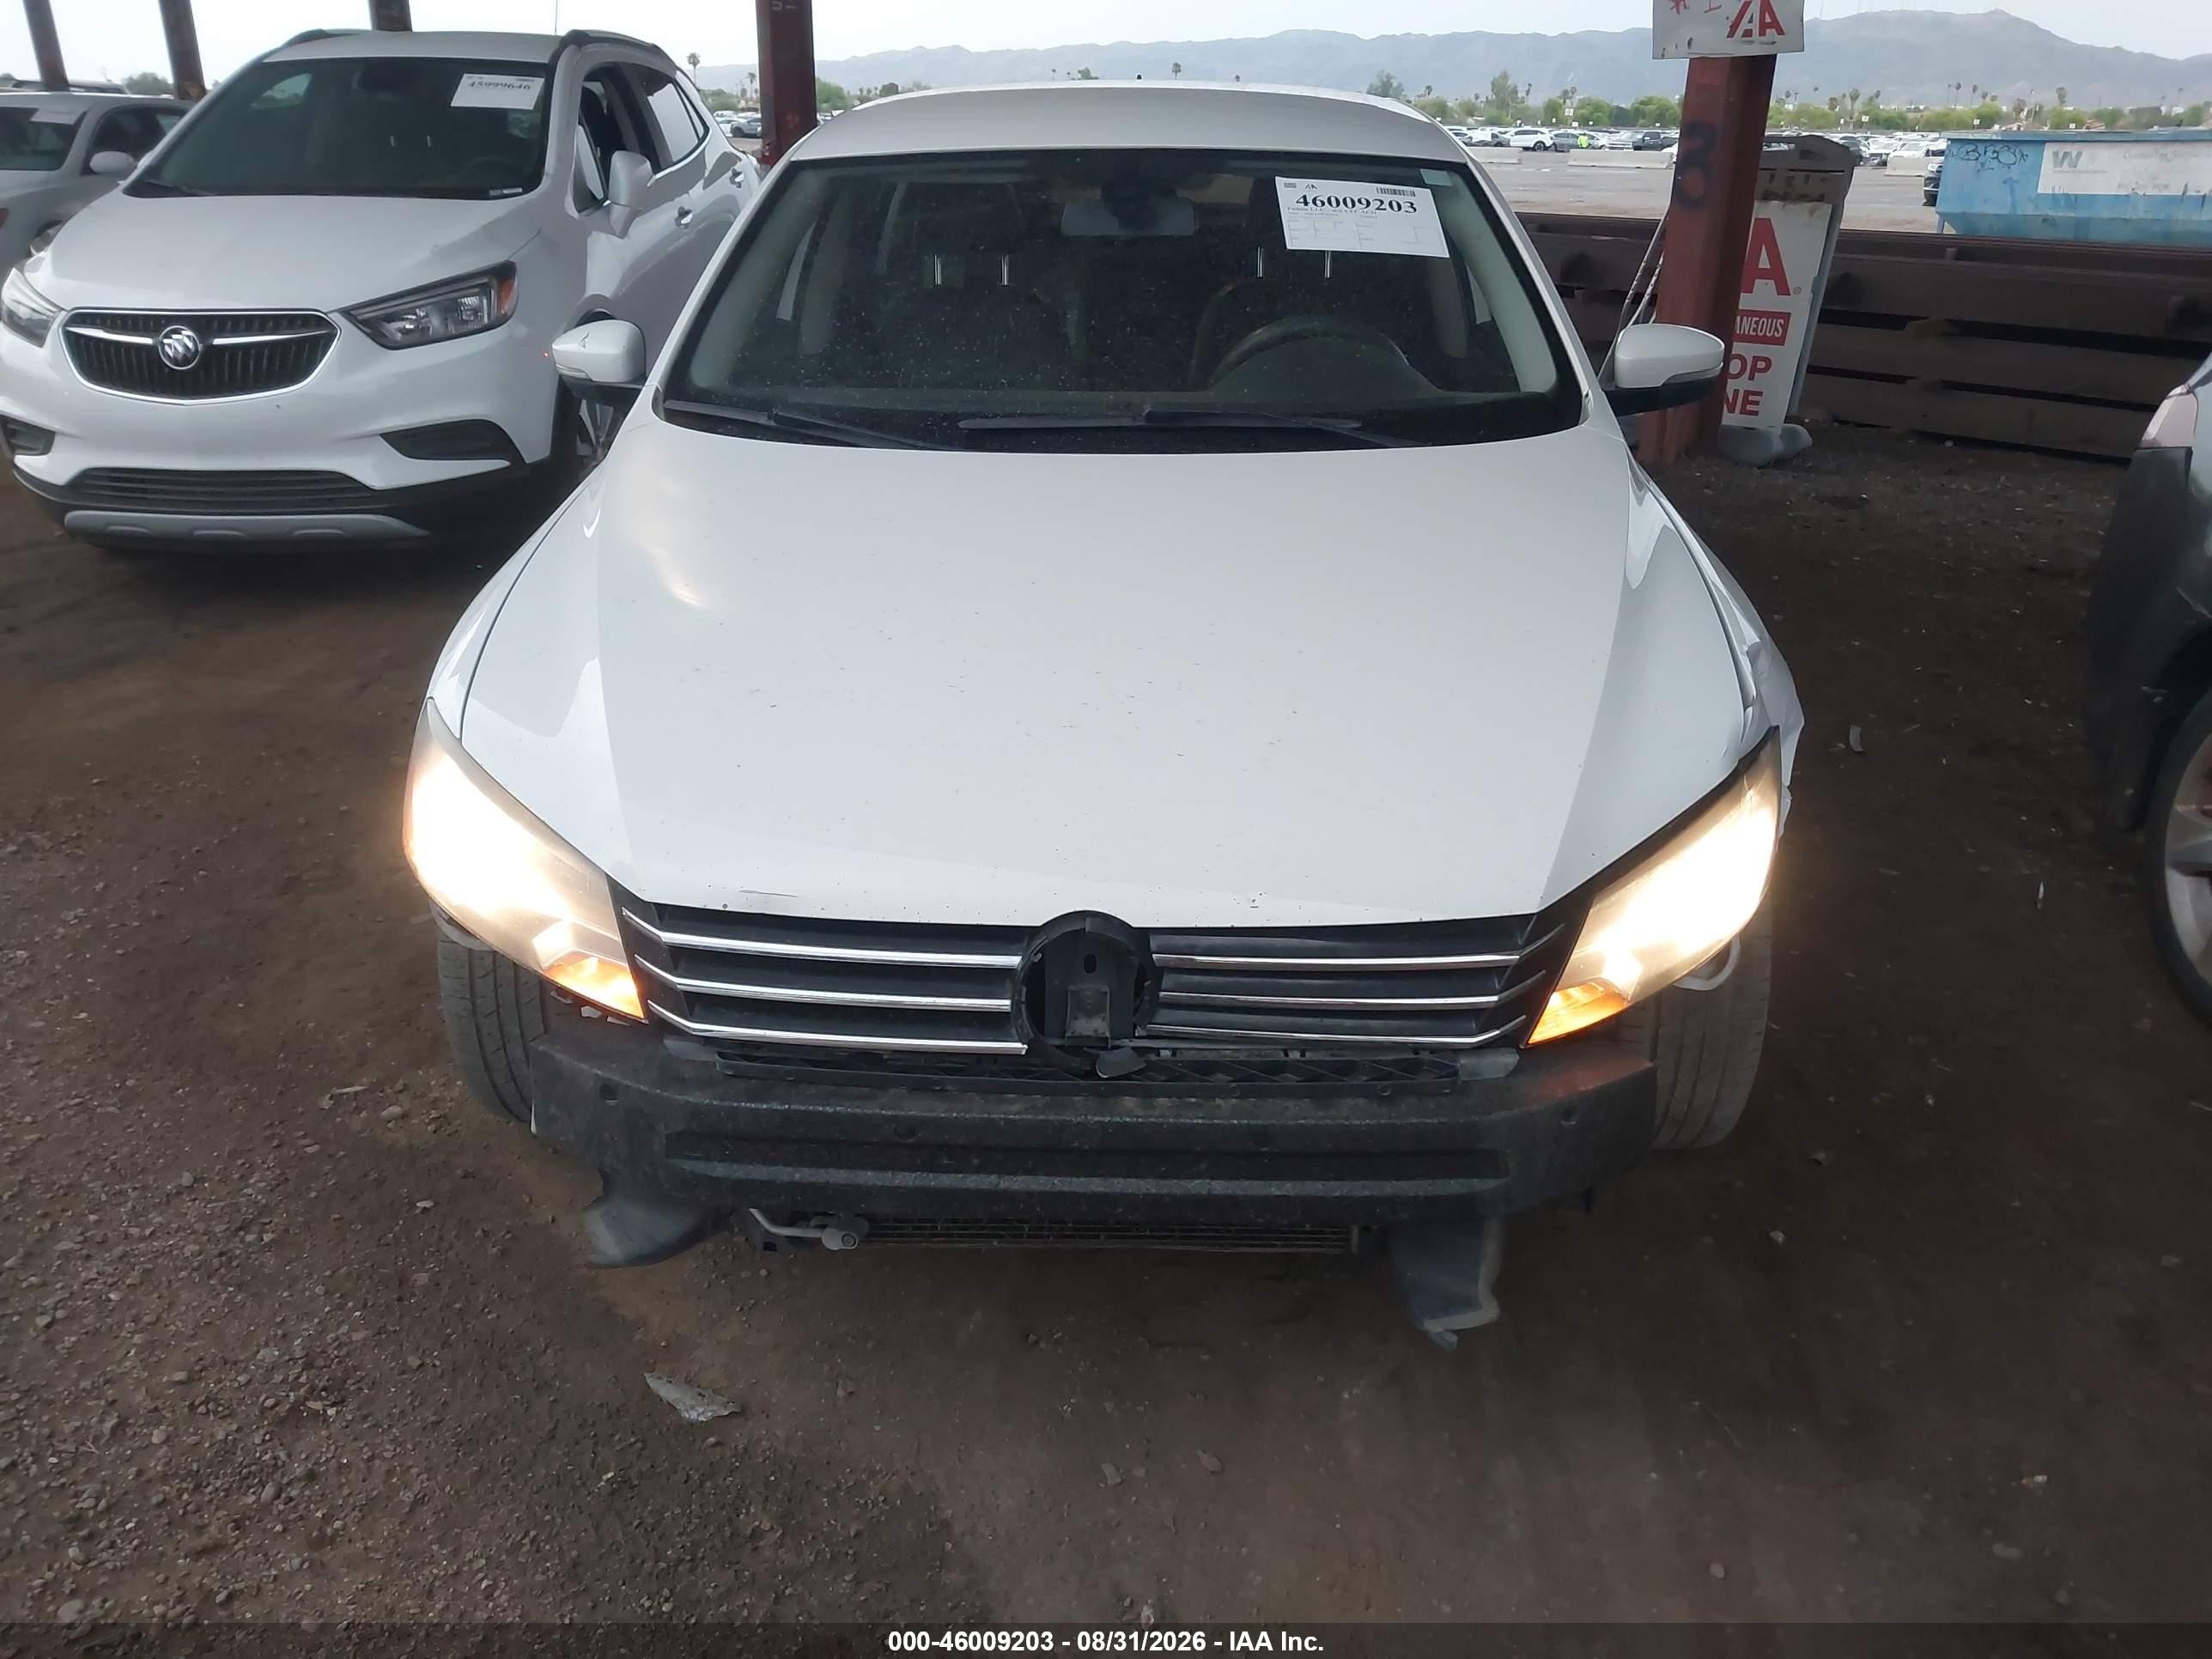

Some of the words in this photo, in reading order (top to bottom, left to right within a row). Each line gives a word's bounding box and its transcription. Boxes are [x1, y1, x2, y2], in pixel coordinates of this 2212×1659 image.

[1296, 194, 1417, 213] 46009203
[1741, 217, 1790, 295] A
[1735, 315, 1784, 337] ANEOUS
[1728, 353, 1772, 381] OP
[1724, 388, 1763, 417] NE
